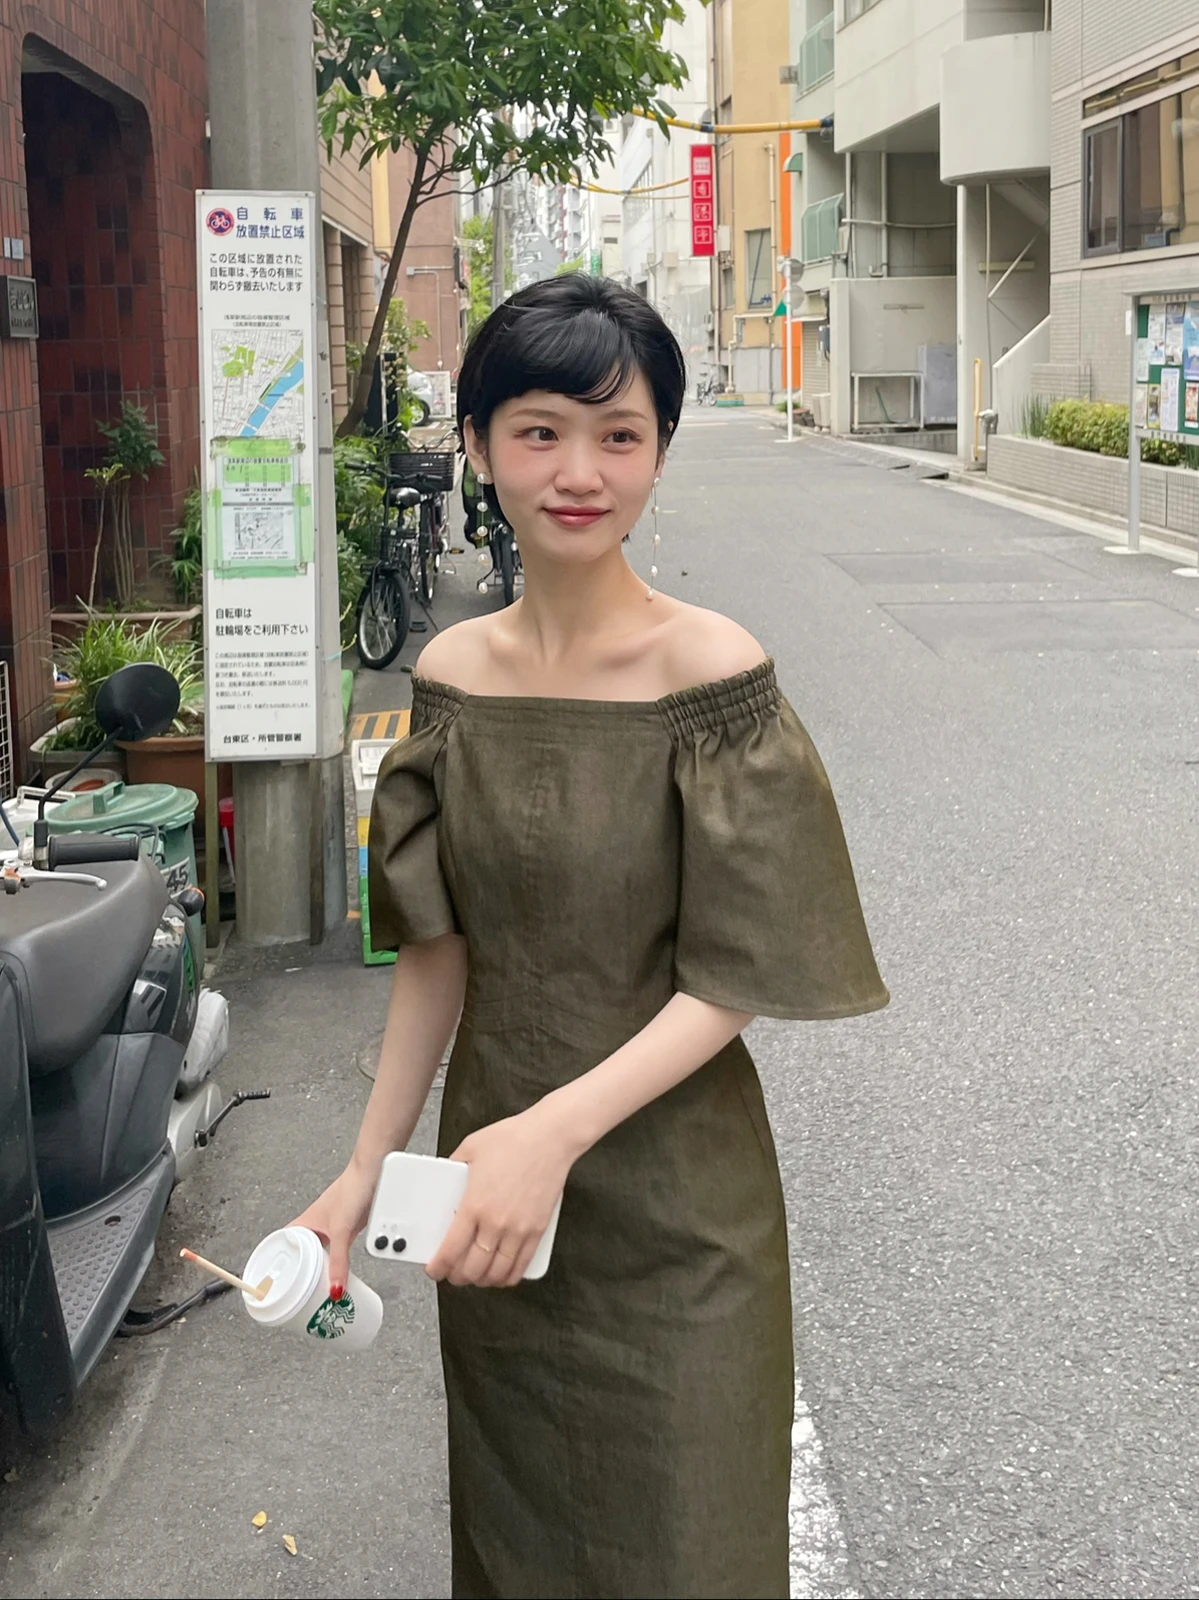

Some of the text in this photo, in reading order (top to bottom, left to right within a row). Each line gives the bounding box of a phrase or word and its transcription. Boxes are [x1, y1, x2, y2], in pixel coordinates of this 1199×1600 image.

[236, 206, 304, 221] 自転車
[236, 225, 305, 239] 放置禁止区域
[209, 253, 303, 265] この区域に放置された
[209, 266, 303, 279] 自転車は、予告の有無に
[209, 280, 303, 292] 関わらず撤去いたします
[215, 608, 252, 619] 自転車は
[215, 624, 309, 636] 駐輪場をご利用下さい
